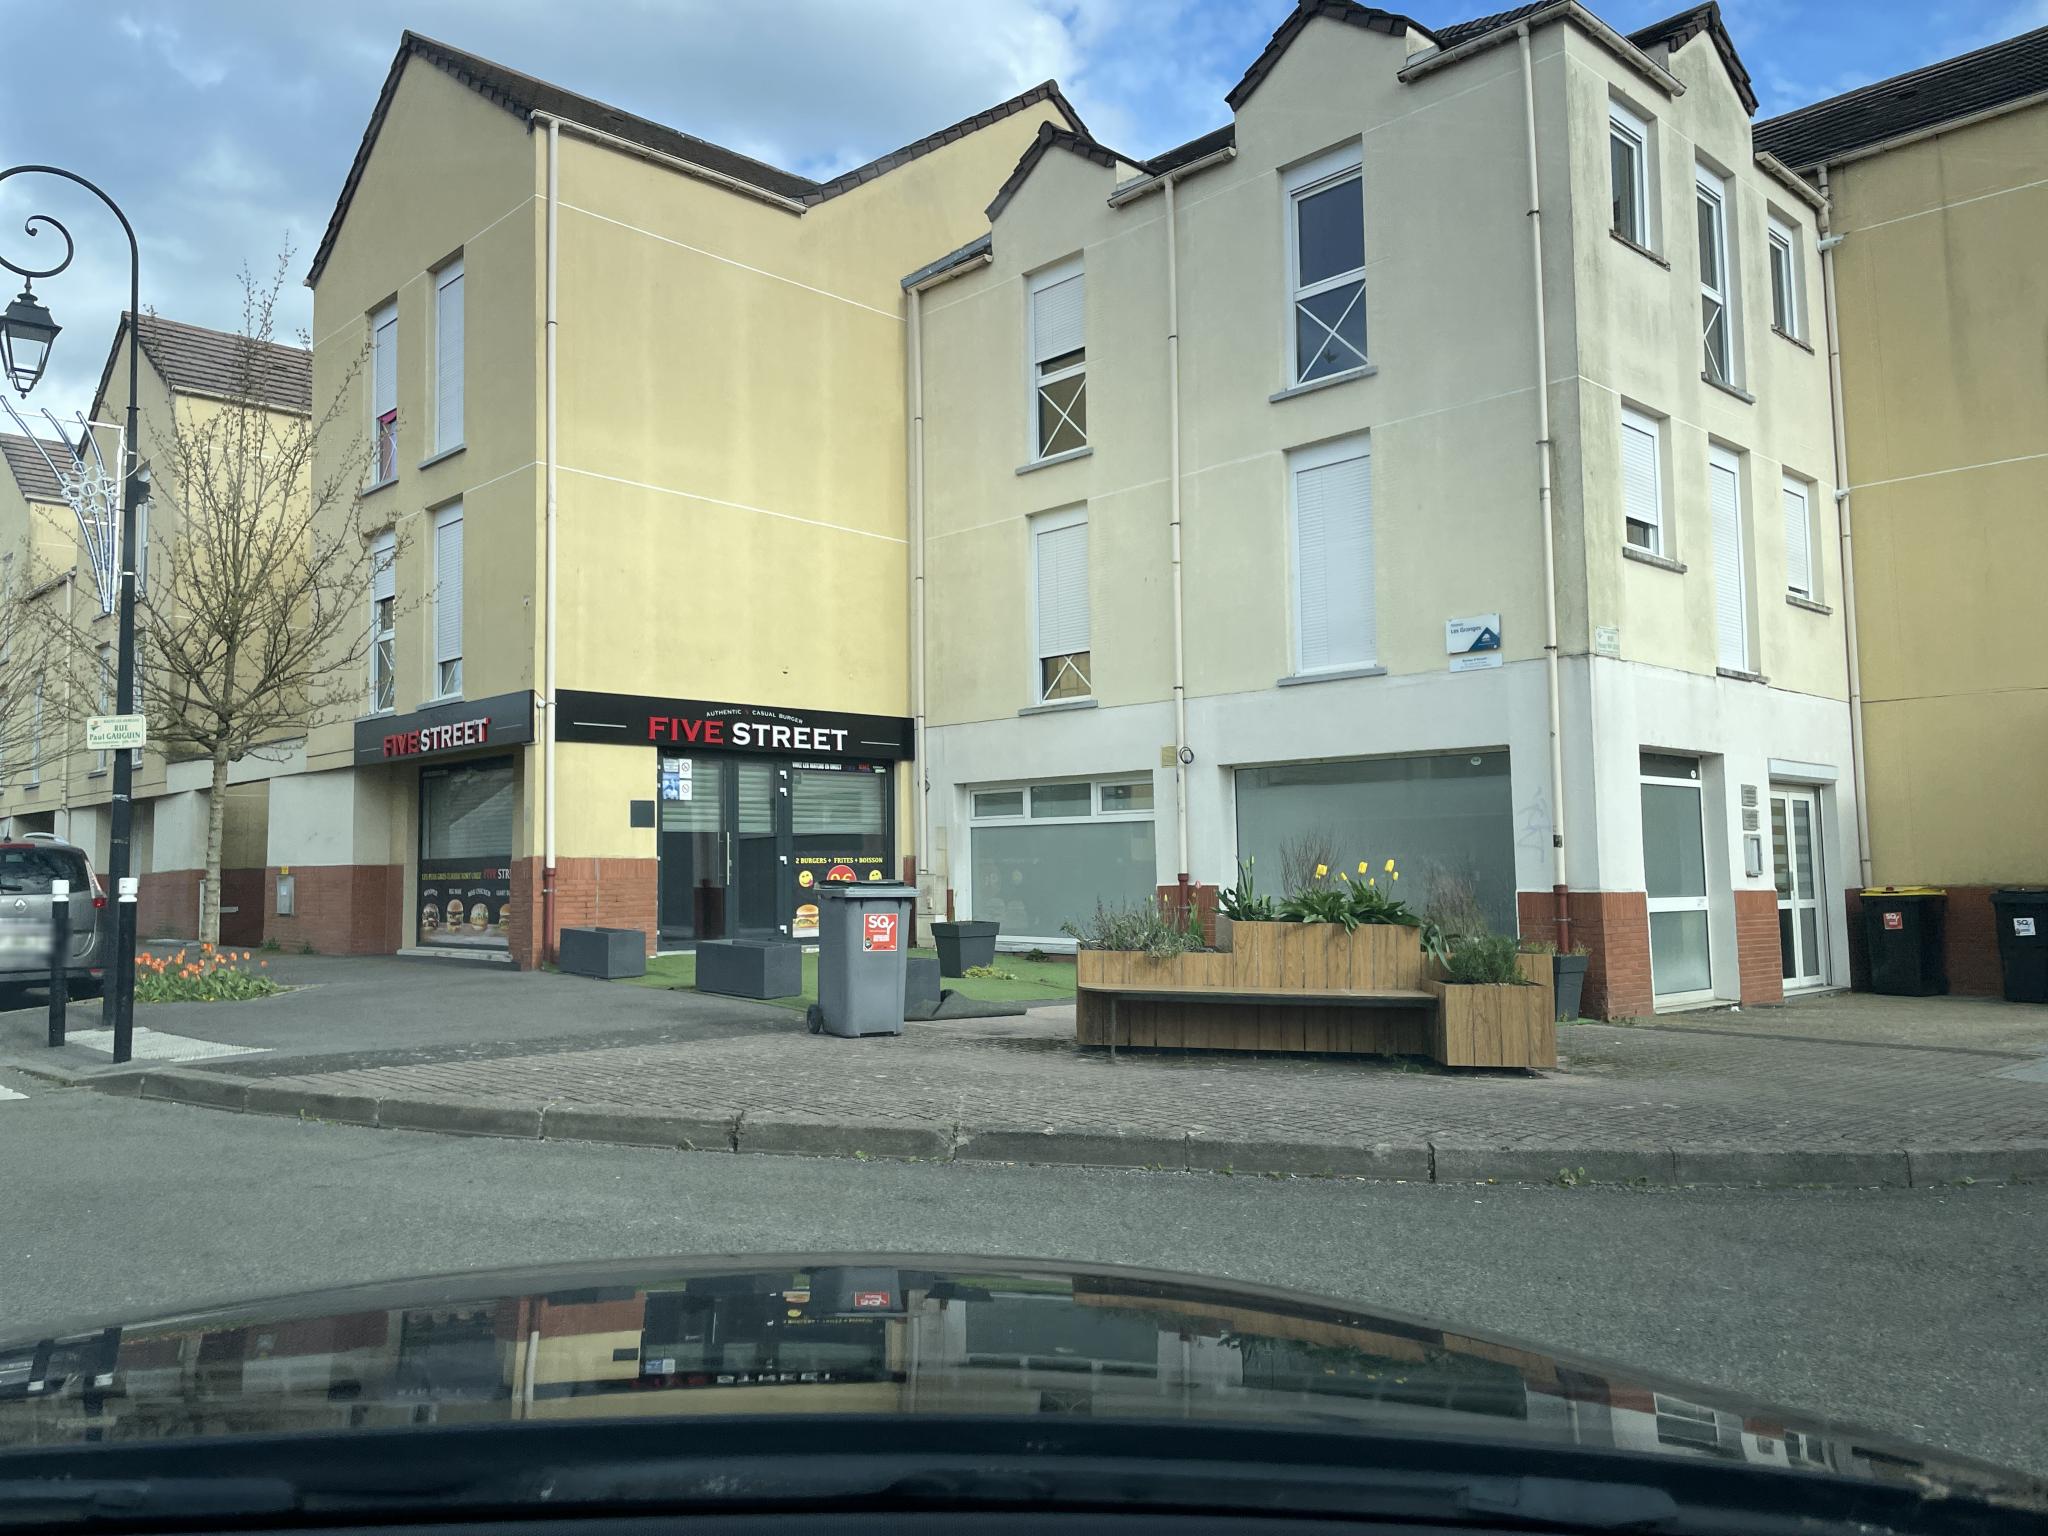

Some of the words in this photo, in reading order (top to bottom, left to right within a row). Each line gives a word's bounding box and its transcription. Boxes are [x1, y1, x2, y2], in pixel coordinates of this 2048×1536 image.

[706, 709, 742, 717] AUTHENTIC
[752, 710, 777, 718] CASUAL
[778, 713, 803, 724] BURGER
[106, 732, 141, 740] GAUGUIN
[383, 730, 420, 757] FIVE
[420, 717, 491, 752] STREET
[648, 716, 724, 745] FIVE
[732, 722, 848, 751] STREET
[498, 868, 511, 879] STR
